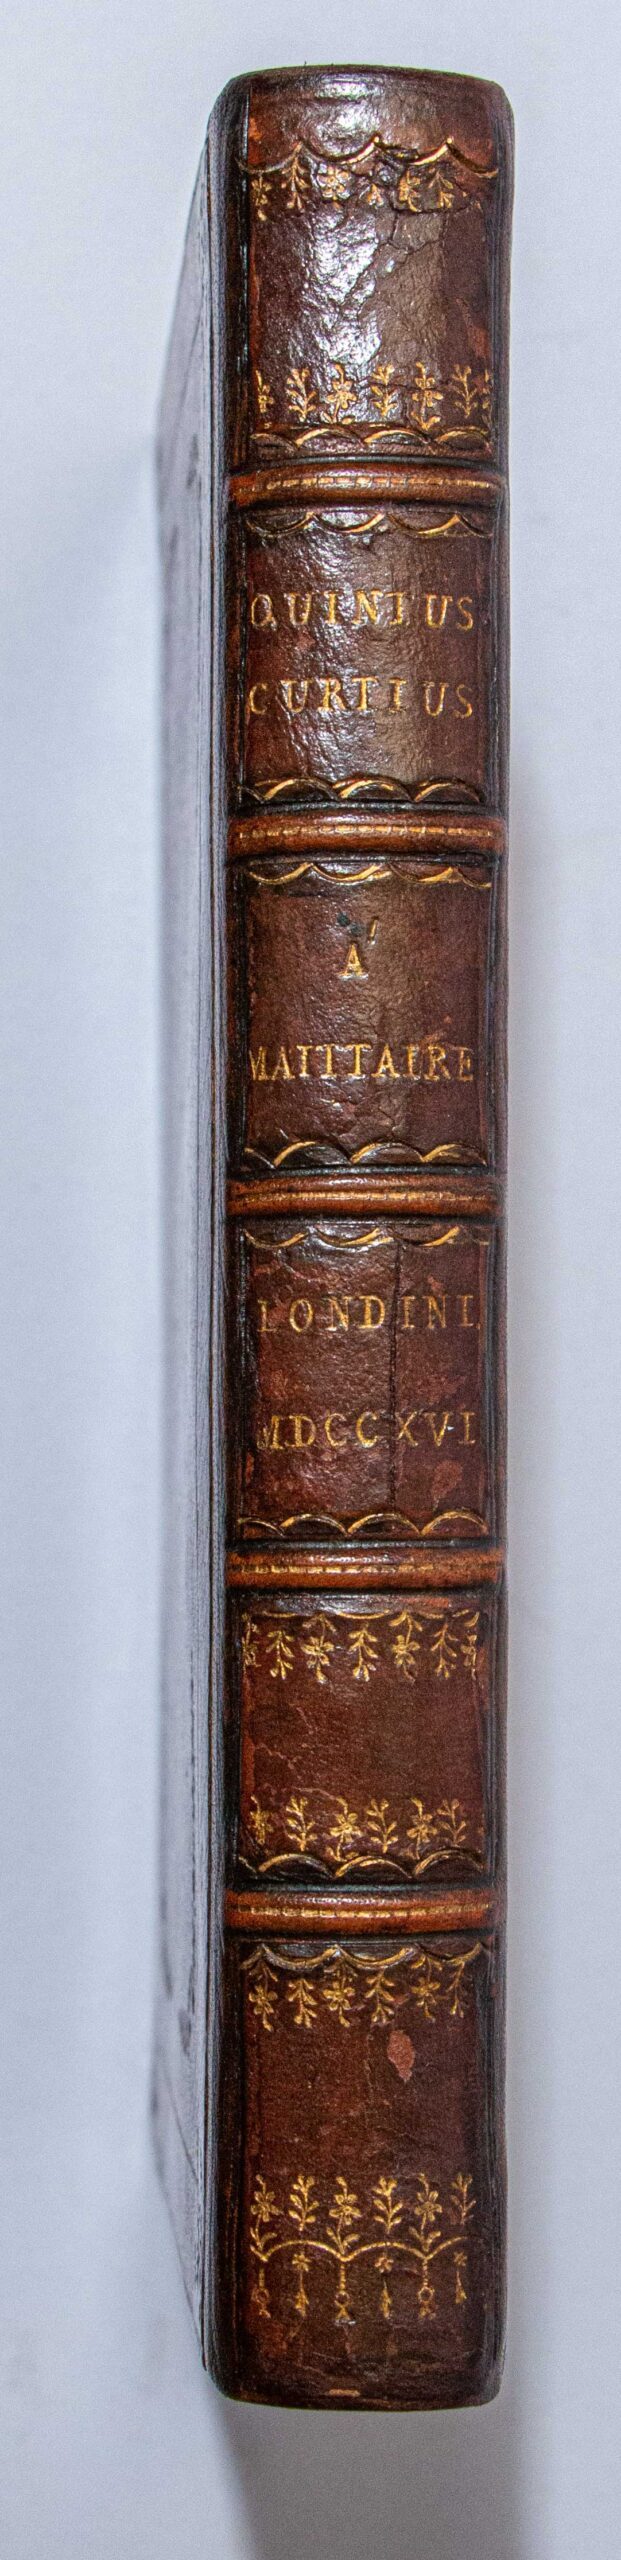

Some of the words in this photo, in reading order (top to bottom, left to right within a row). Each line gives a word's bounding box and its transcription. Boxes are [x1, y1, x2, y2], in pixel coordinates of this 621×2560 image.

[249, 677, 472, 718] CURTIUS
[249, 1042, 473, 1082] MAITTAIRE
[257, 1411, 475, 1450] MDCCXVI
